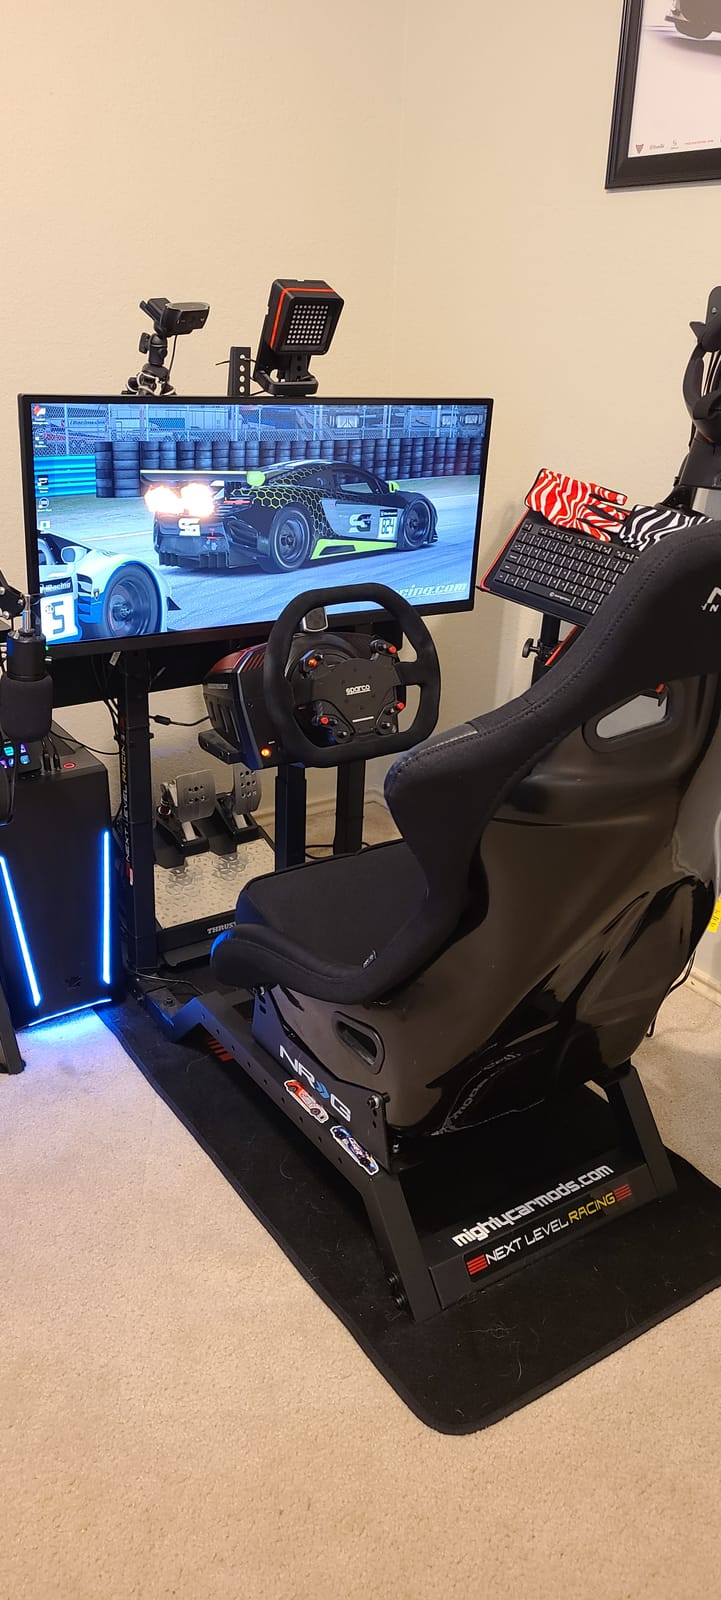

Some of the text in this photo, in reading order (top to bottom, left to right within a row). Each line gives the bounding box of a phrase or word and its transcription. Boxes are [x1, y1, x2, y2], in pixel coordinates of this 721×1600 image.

[51, 600, 66, 635] 5
[345, 684, 371, 696] sparco
[451, 1164, 614, 1248] mightycarmods.com
[484, 1191, 616, 1265] NEXT LEVEL RACING
